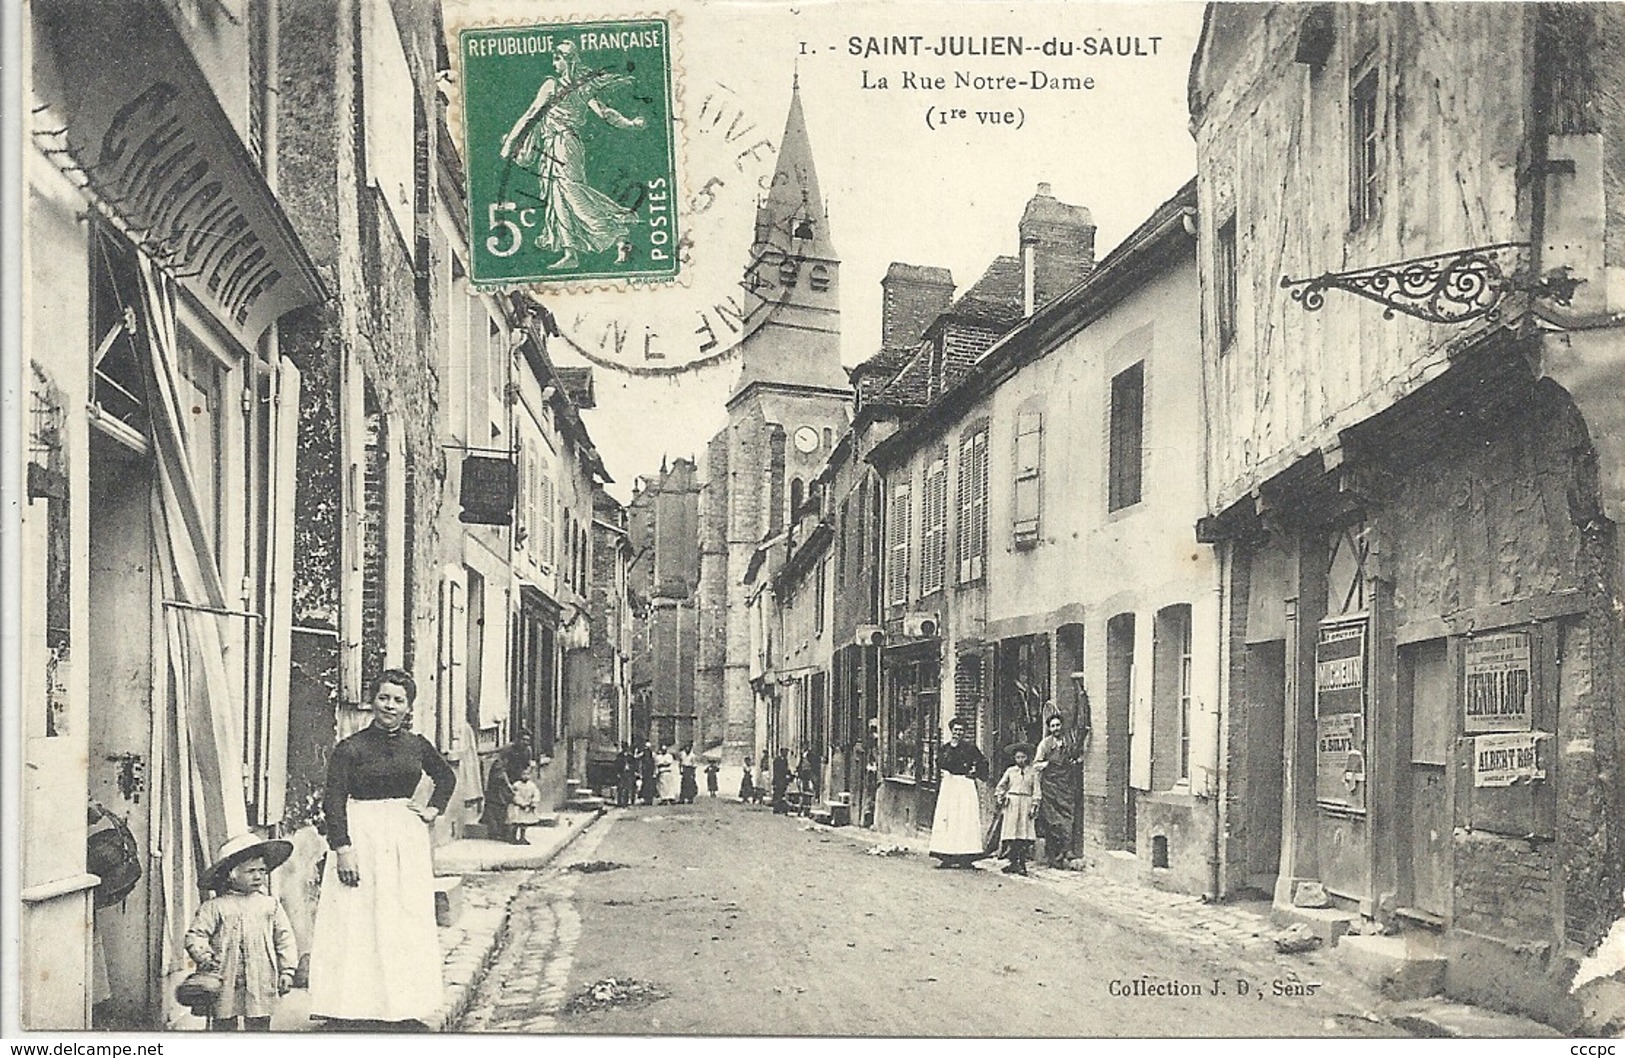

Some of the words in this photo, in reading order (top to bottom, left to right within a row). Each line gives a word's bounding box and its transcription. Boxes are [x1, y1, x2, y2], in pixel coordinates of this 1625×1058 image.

[580, 31, 660, 52] FRANÇAISE
[101, 81, 282, 327] CHARCUTERIE
[648, 177, 669, 261] POSTES
[1500, 669, 1529, 715] LOUP
[1478, 748, 1515, 773] ALBERT
